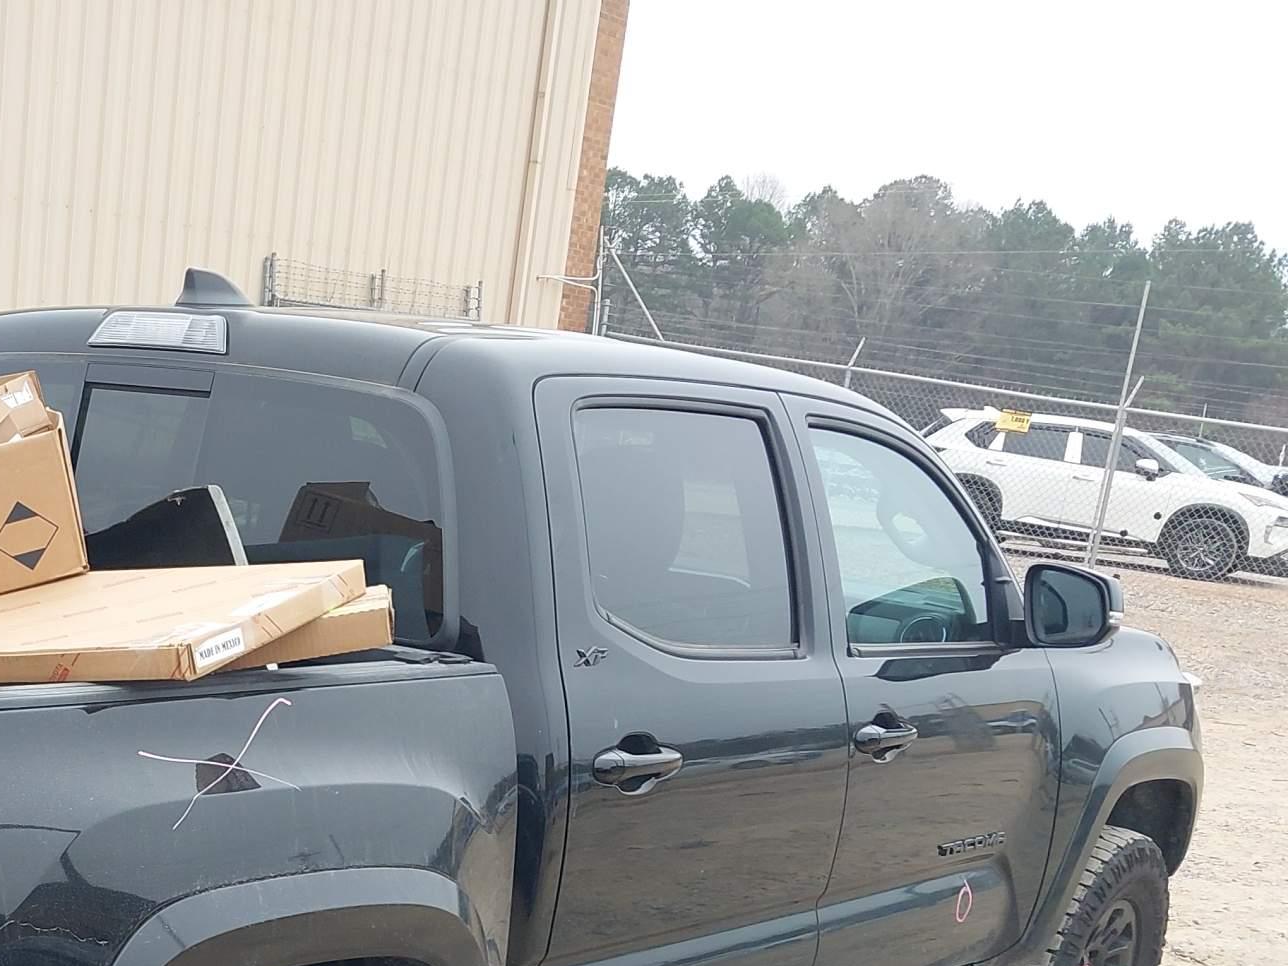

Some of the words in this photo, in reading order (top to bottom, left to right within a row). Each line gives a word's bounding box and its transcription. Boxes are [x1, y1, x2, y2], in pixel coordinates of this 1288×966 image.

[199, 647, 215, 661] MADE
[221, 636, 242, 652] MEXICO
[937, 831, 1007, 857] TACOMA
